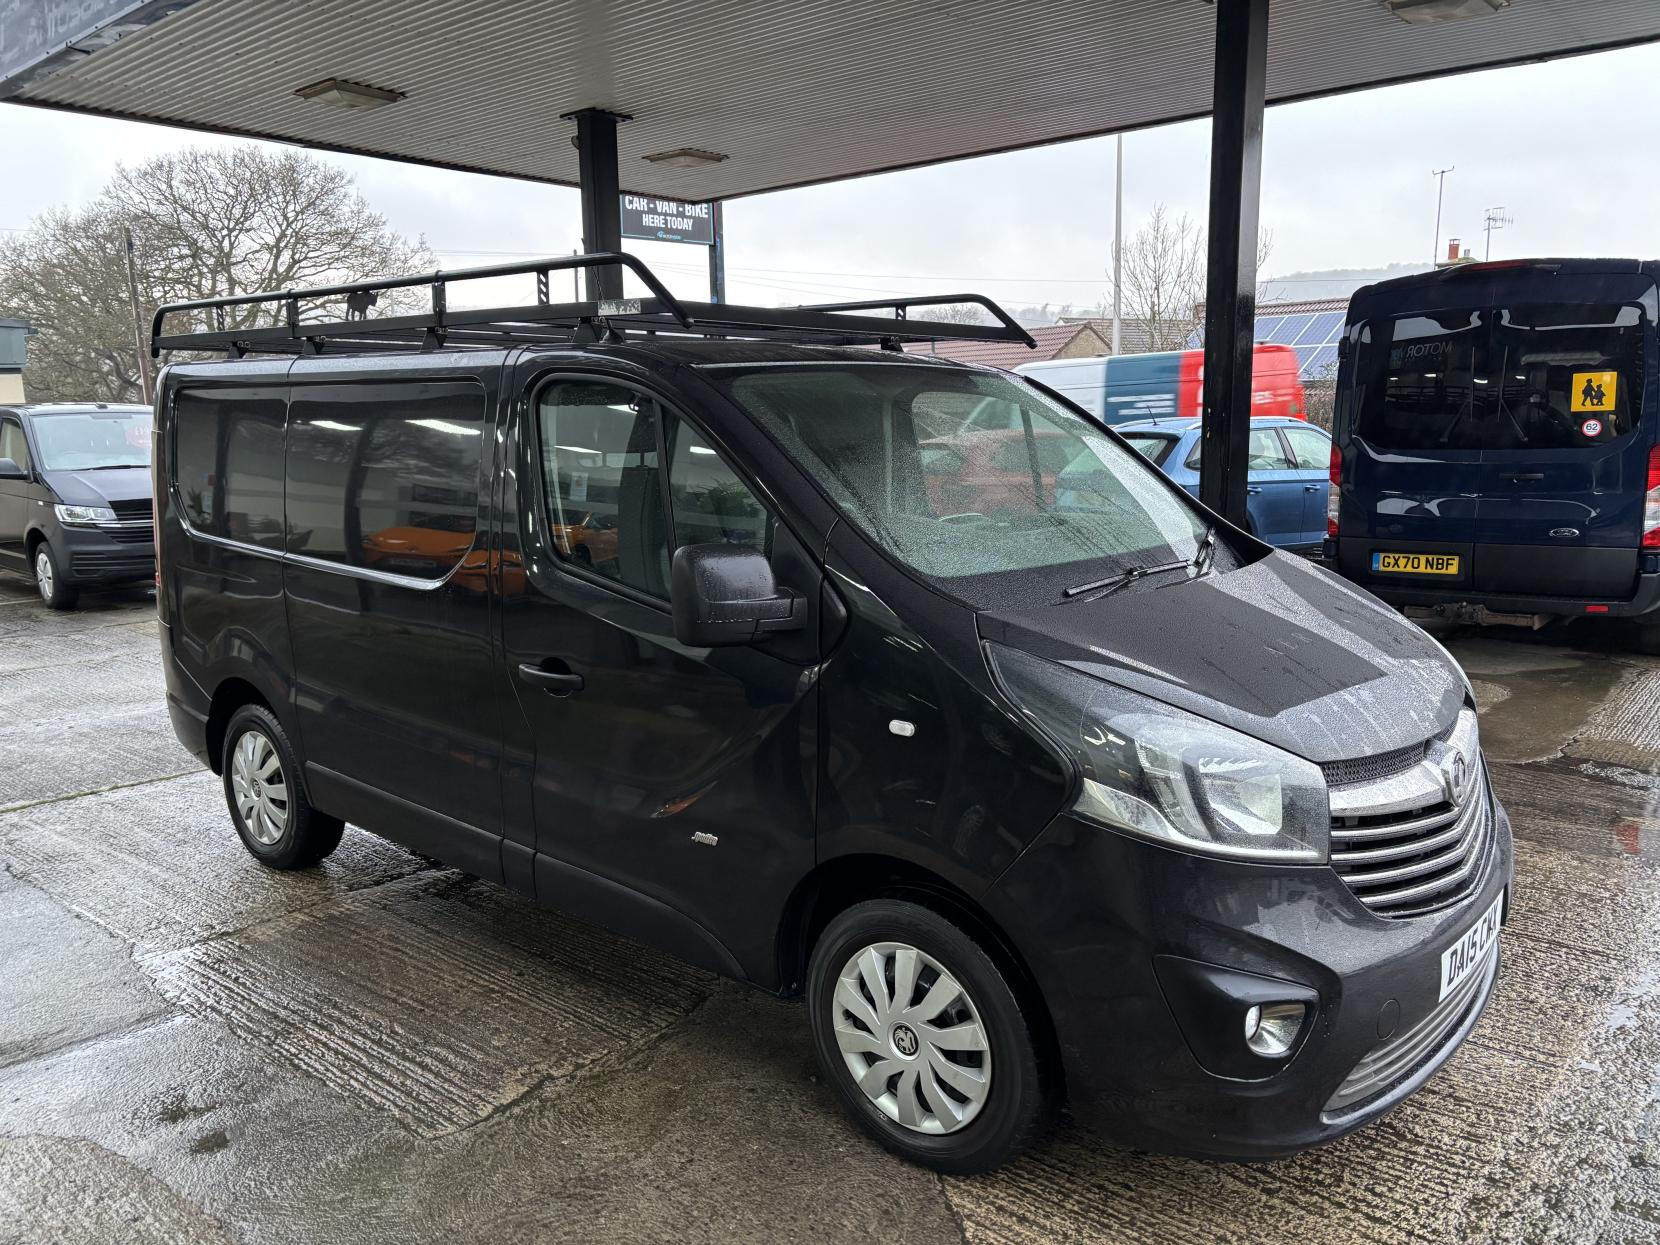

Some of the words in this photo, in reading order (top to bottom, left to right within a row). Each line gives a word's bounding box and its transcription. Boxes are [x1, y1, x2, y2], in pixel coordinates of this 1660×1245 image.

[625, 195, 648, 211] CAR
[656, 200, 677, 214] VAN
[685, 203, 709, 218] BIKE
[642, 213, 666, 227] HERE
[666, 215, 693, 230] TODAY
[1585, 423, 1598, 431] 62
[1382, 555, 1421, 570] GX70
[1424, 556, 1455, 571] NBF
[1446, 926, 1479, 988] DA15
